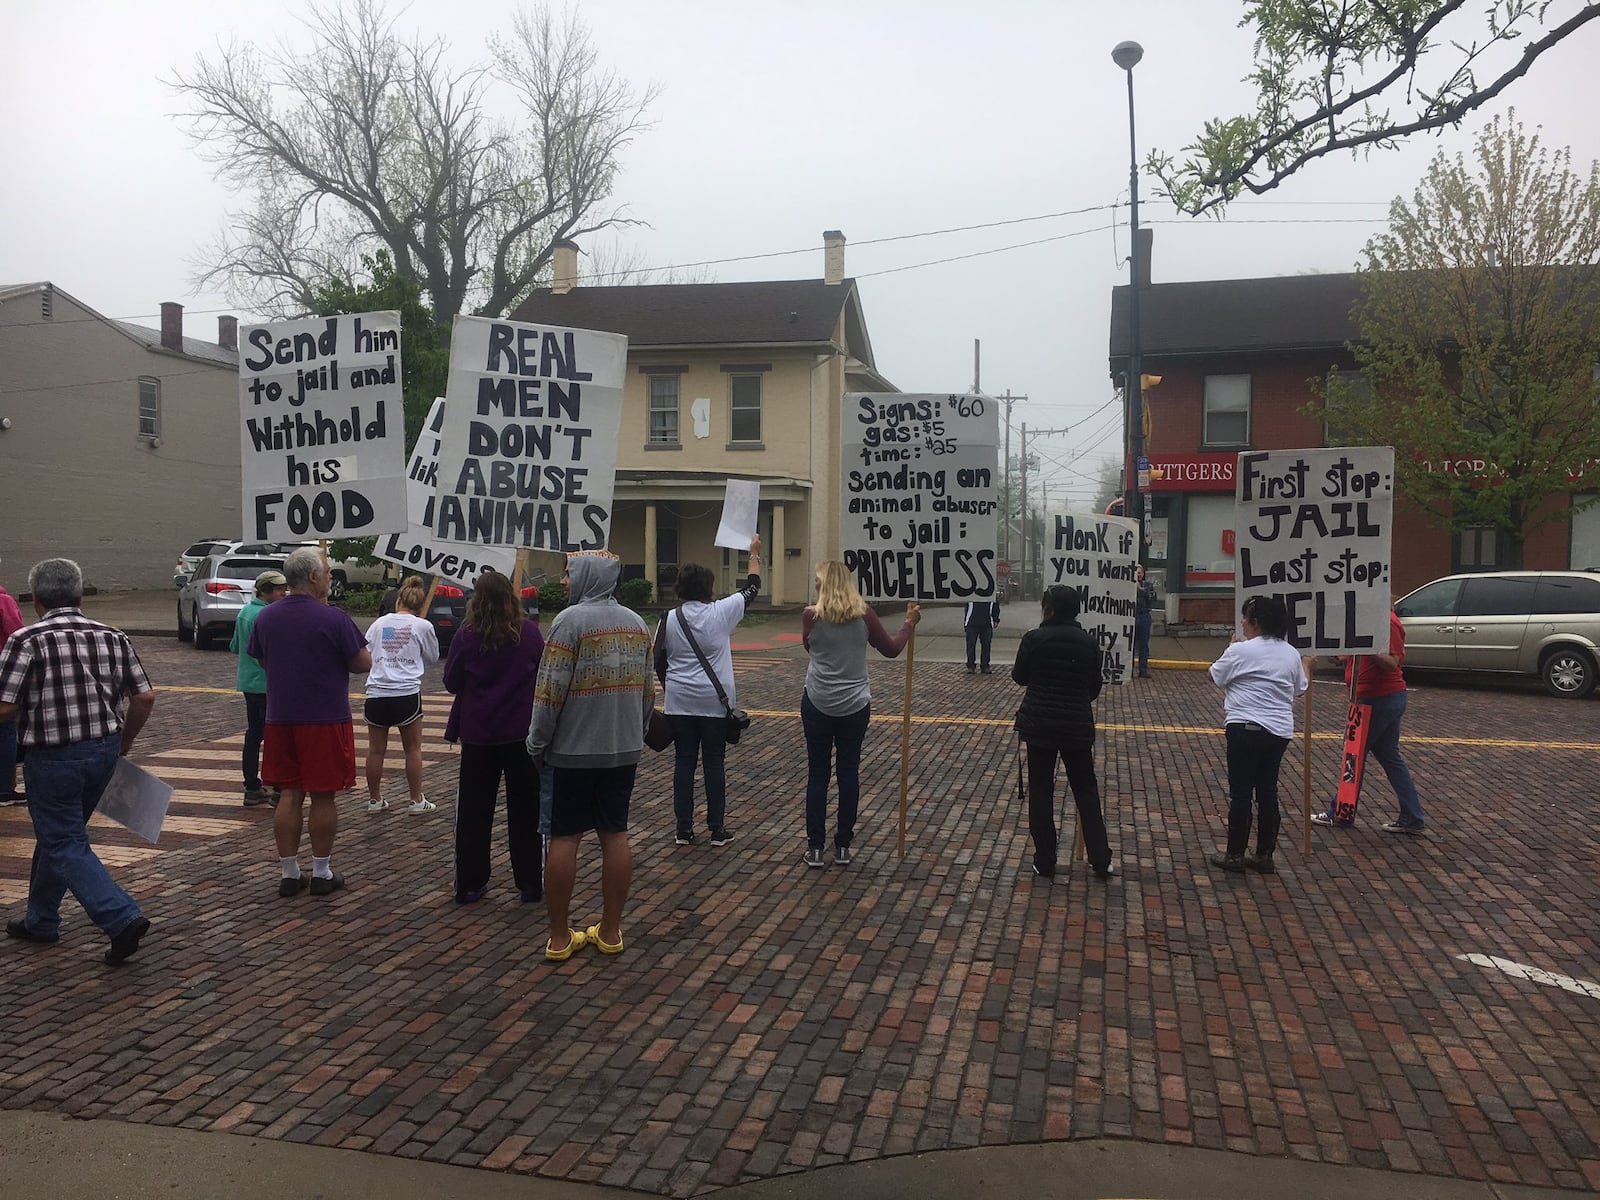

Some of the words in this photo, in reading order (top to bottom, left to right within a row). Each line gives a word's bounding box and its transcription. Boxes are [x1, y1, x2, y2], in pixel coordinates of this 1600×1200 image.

[245, 319, 338, 372] Send
[354, 318, 398, 353] him
[487, 324, 592, 382] REAL
[248, 378, 282, 405] to
[289, 360, 338, 406] jail
[351, 356, 395, 389] and
[477, 378, 581, 422] MEN
[246, 400, 386, 452] Withhold
[857, 397, 941, 427] Signs:
[469, 421, 592, 461] DON'T
[863, 426, 920, 447] gas:
[922, 421, 945, 436] $5
[287, 455, 341, 486] his
[455, 458, 588, 503] ABUSE
[956, 467, 991, 488] an
[1243, 452, 1310, 501] First
[1321, 457, 1390, 498] stop:
[255, 489, 374, 540] FOOD
[437, 495, 609, 551] ANIMALS
[848, 494, 921, 513] animal
[932, 496, 997, 515] abuser
[1249, 502, 1380, 542] JAIL
[863, 517, 892, 540] to
[1119, 534, 1132, 554] if
[1050, 557, 1089, 582] you
[1241, 548, 1318, 588] Last
[1324, 548, 1388, 588] stop:
[1123, 625, 1133, 651] 4
[1252, 590, 1374, 649] ELL
